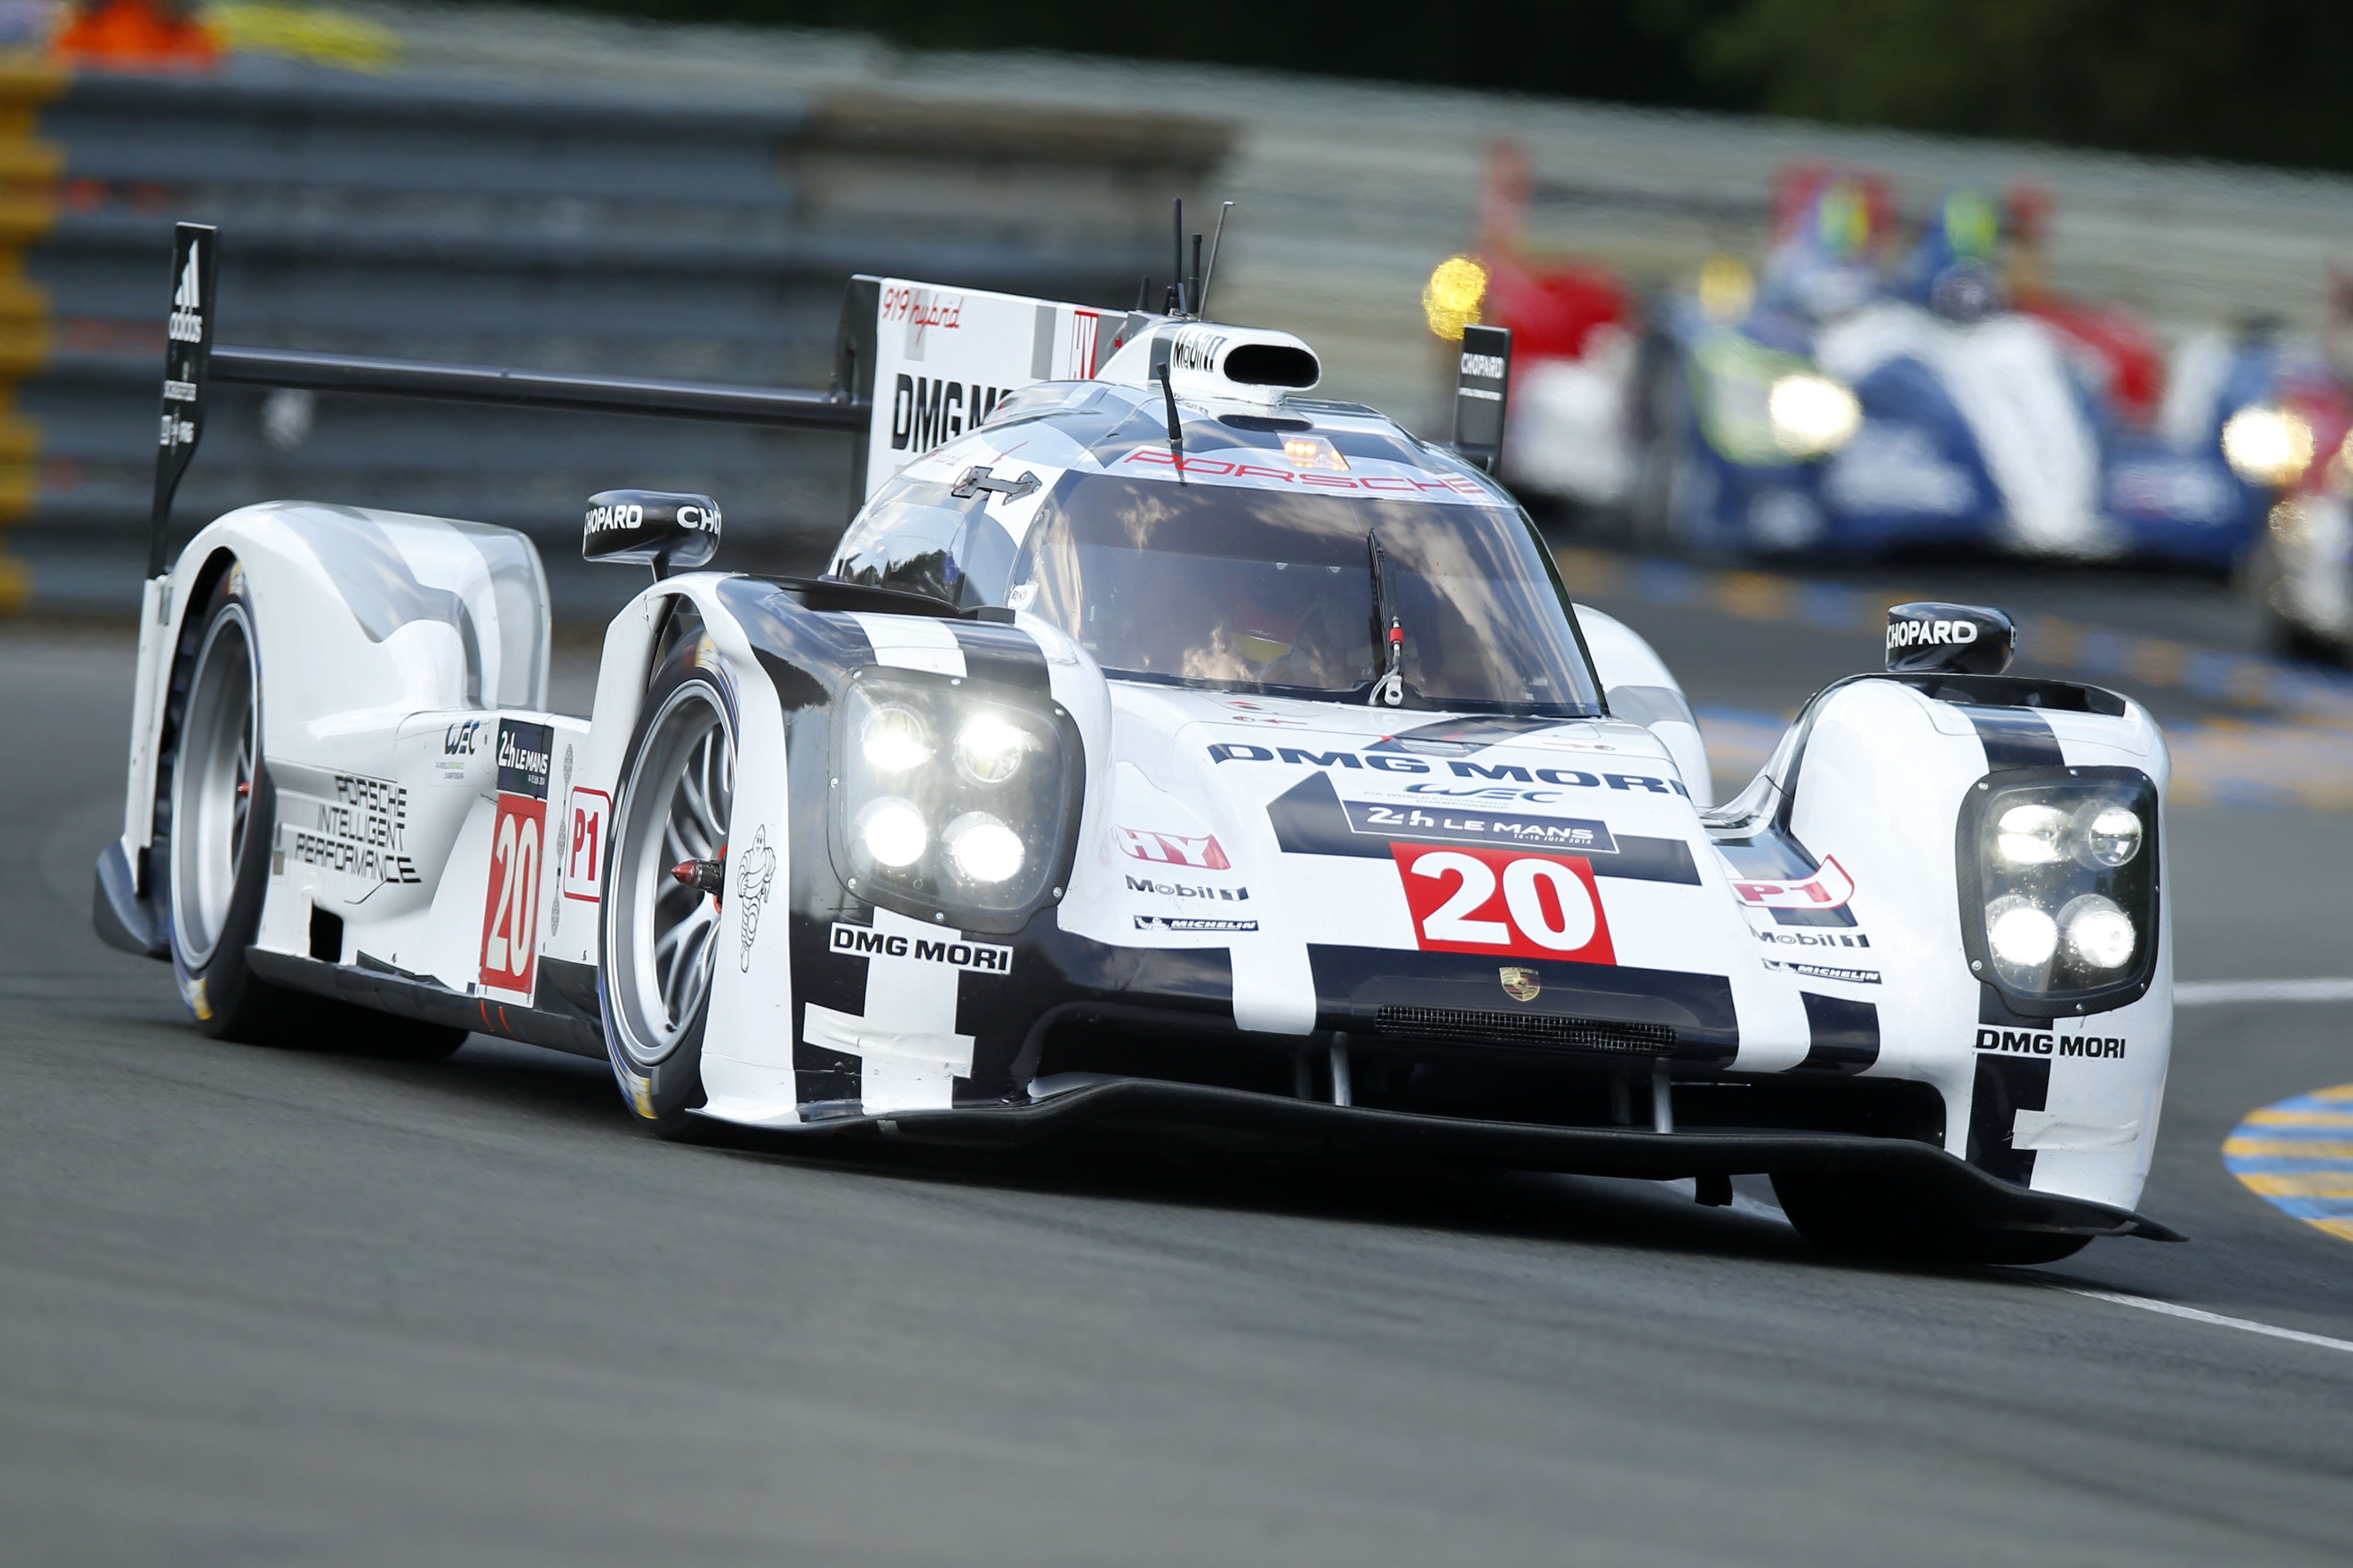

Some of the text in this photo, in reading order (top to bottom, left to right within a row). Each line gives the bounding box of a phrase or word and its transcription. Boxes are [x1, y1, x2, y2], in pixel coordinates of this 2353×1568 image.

[882, 288, 964, 347] 919 hybrid
[892, 373, 962, 453] DMG
[1123, 450, 1487, 494] PORSCHE
[1887, 620, 1978, 650] CHOPARD
[445, 719, 480, 755] WEC
[514, 749, 527, 770] LE
[526, 750, 549, 774] MANS
[1207, 743, 1692, 801] DMG MORI
[334, 776, 407, 818] PORSCHE
[1386, 792, 1430, 801] WORLD
[1431, 796, 1510, 806] ENDURANCE
[1404, 783, 1563, 803] WEC
[1415, 799, 1509, 810] CHAMPIONSHIP
[318, 803, 405, 852] INTELLIGENT
[569, 807, 599, 882] P1
[1443, 818, 1485, 831] LE
[1493, 821, 1594, 840] MANS
[295, 832, 422, 883] PERFORMANCE
[1113, 826, 1209, 867] HY
[486, 813, 539, 977] 20
[1125, 874, 1215, 899] Mobil
[1410, 850, 1597, 951] 20
[1733, 880, 1833, 903] P1
[1171, 920, 1256, 930] MICHELIN
[1748, 925, 1836, 947] Mobil
[834, 927, 1008, 971] DMG MORI
[1797, 965, 1878, 981] MICHELIN
[1976, 1029, 2126, 1059] DMG MORI
